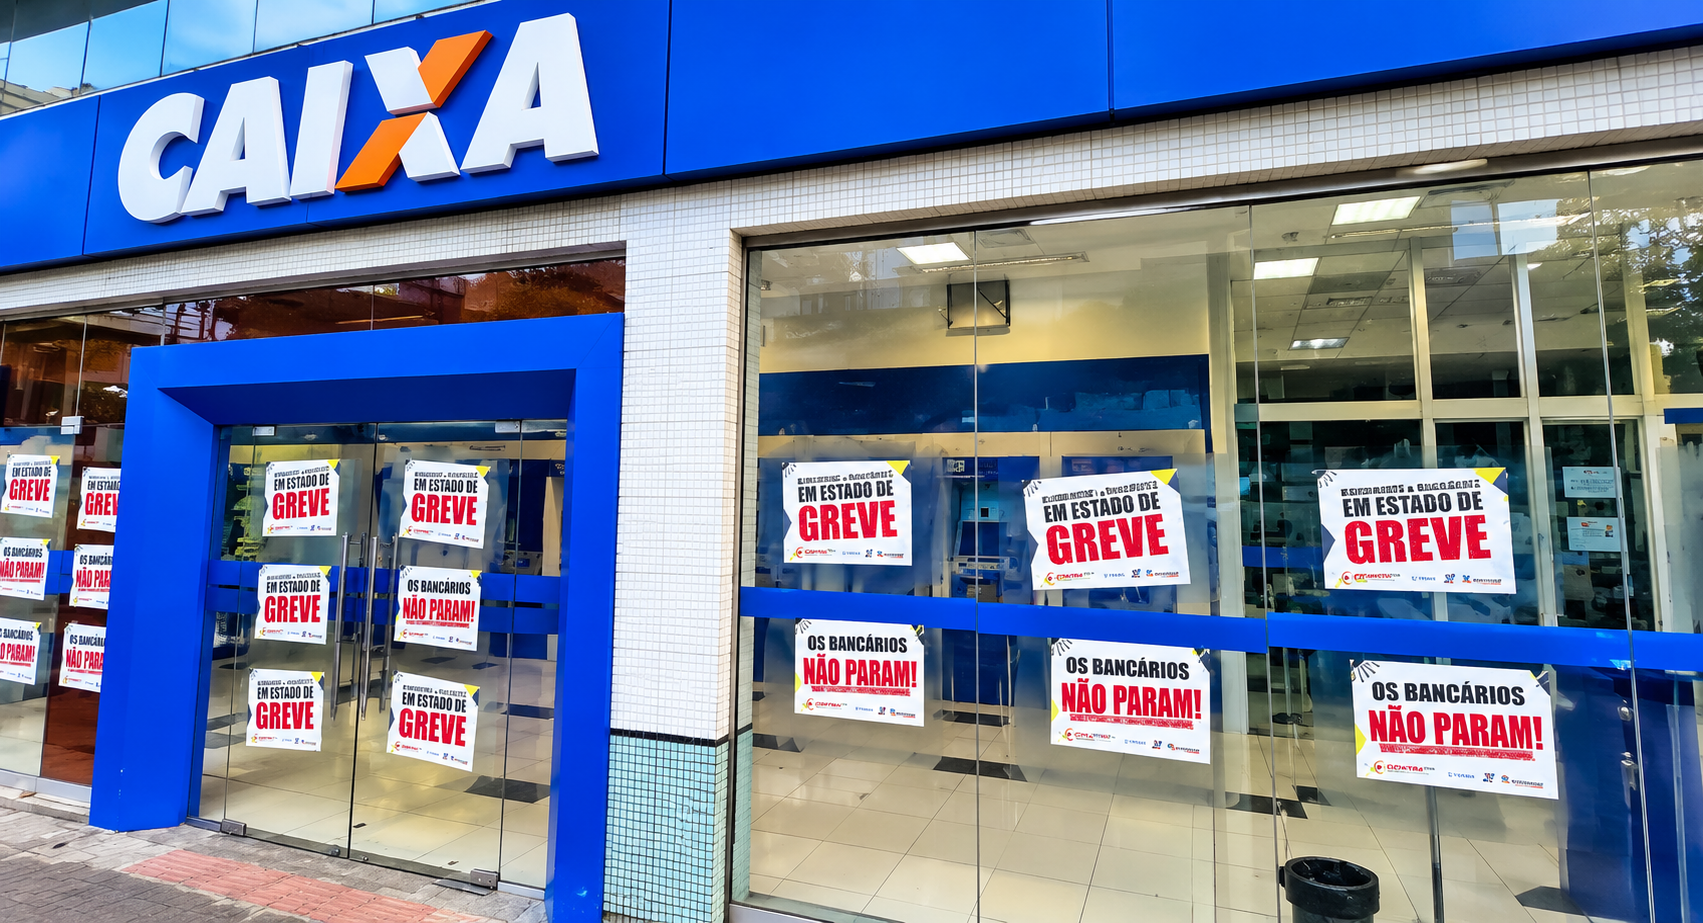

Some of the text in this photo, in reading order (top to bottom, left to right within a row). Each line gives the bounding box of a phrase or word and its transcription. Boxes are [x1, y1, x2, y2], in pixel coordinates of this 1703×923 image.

[117, 12, 599, 225] CAIXA
[274, 473, 330, 491] EM ESTADO DE
[414, 478, 478, 493] EM ESTADO DE
[798, 480, 894, 502] EM ESTADO DE
[272, 488, 330, 520] GREVE
[411, 493, 477, 526] GREVE
[1044, 503, 1068, 523] EM
[1071, 495, 1134, 520] ESTADO
[1138, 491, 1160, 512] DE
[1343, 491, 1483, 517] EM ESTADO DE
[799, 500, 898, 542] GREVE
[1046, 514, 1169, 565] GREVE
[1345, 514, 1491, 565] GREVE
[266, 580, 320, 593] EM ESTADO DE
[408, 577, 471, 594] OS BANCÁRIOS
[265, 595, 321, 623] GREVE
[403, 594, 476, 622] NÃO PARAM!
[808, 634, 907, 653] OS BANCÁRIOS
[803, 653, 917, 688] NÃO PARAM!
[1066, 656, 1189, 680] OS BANCÁRIOS
[257, 686, 314, 700] EM ESTADO DE
[402, 692, 466, 713] EM ESTADO DE
[1061, 678, 1201, 720] NÃO PARAM!
[1371, 681, 1525, 706] OS BANCÁRIOS
[256, 701, 314, 730] GREVE
[399, 708, 466, 747] GREVE
[1368, 704, 1543, 750] NÃO PARAM!
